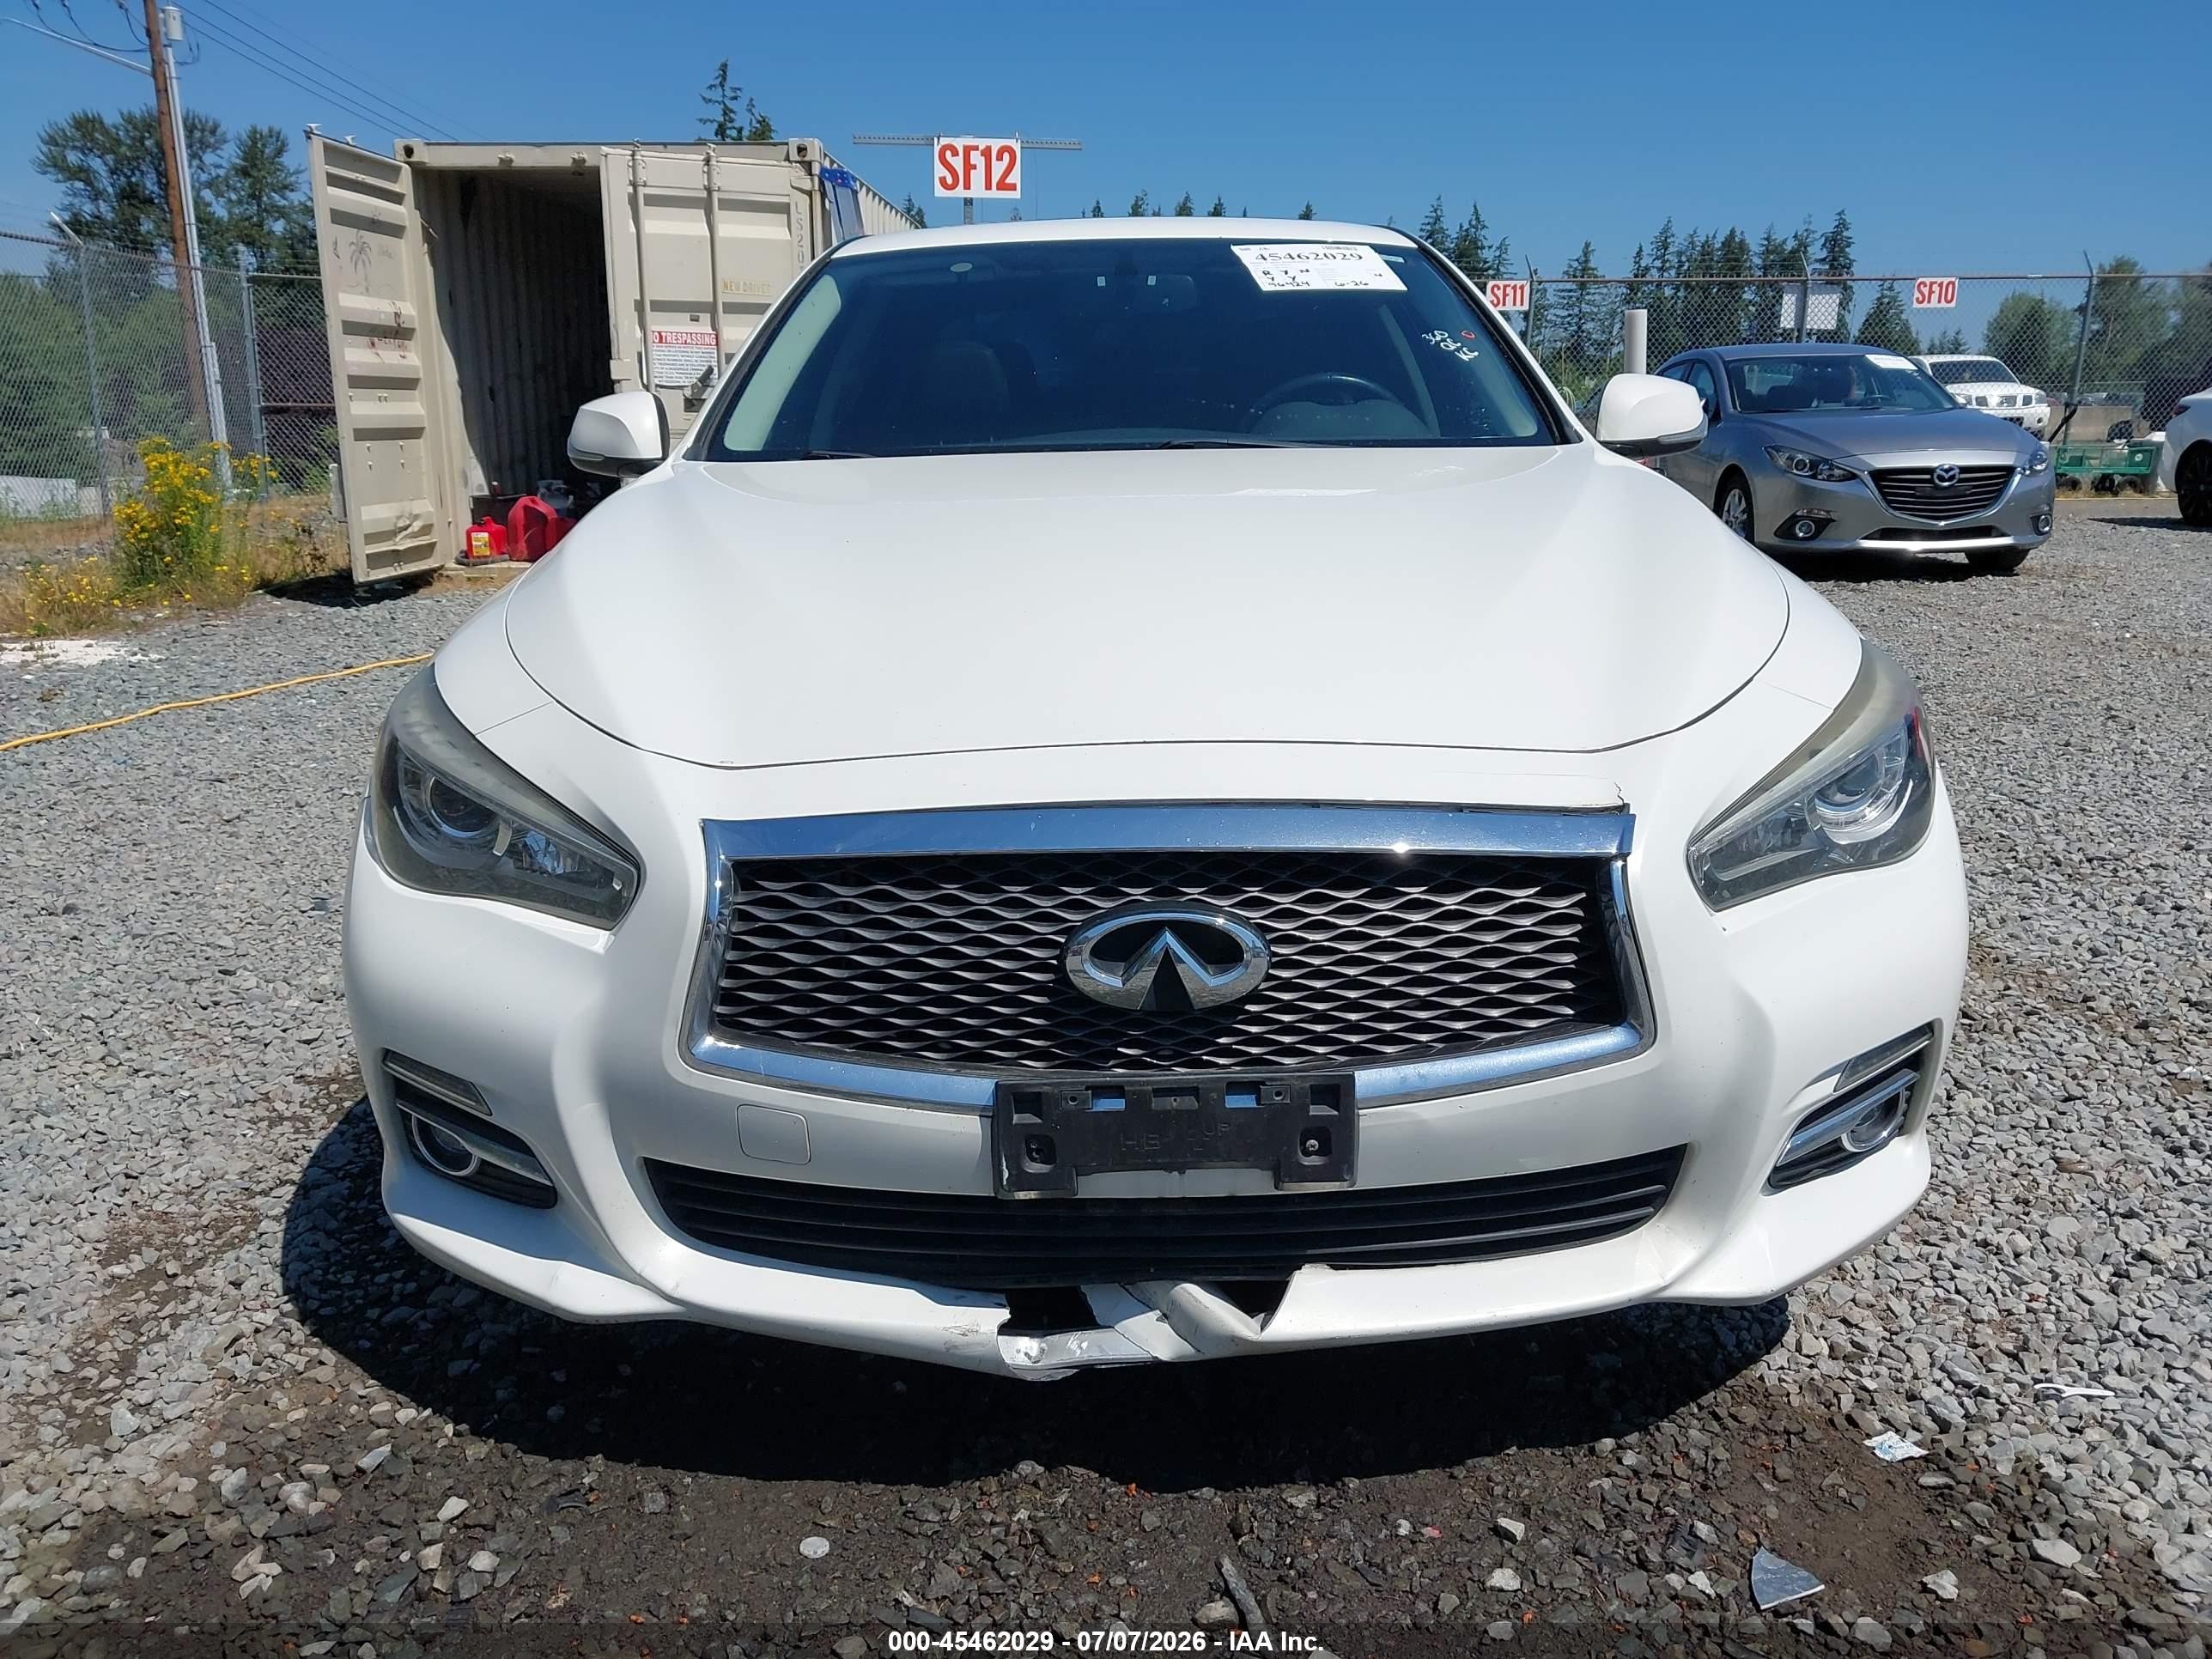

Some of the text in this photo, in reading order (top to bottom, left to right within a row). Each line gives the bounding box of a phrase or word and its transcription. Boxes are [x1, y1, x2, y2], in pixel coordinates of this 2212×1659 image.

[938, 143, 1017, 191] SF12
[1255, 252, 1363, 261] 45462029
[1490, 283, 1525, 308] SF11
[1915, 280, 1956, 305] SF10
[660, 332, 717, 345] TRESPASSING
